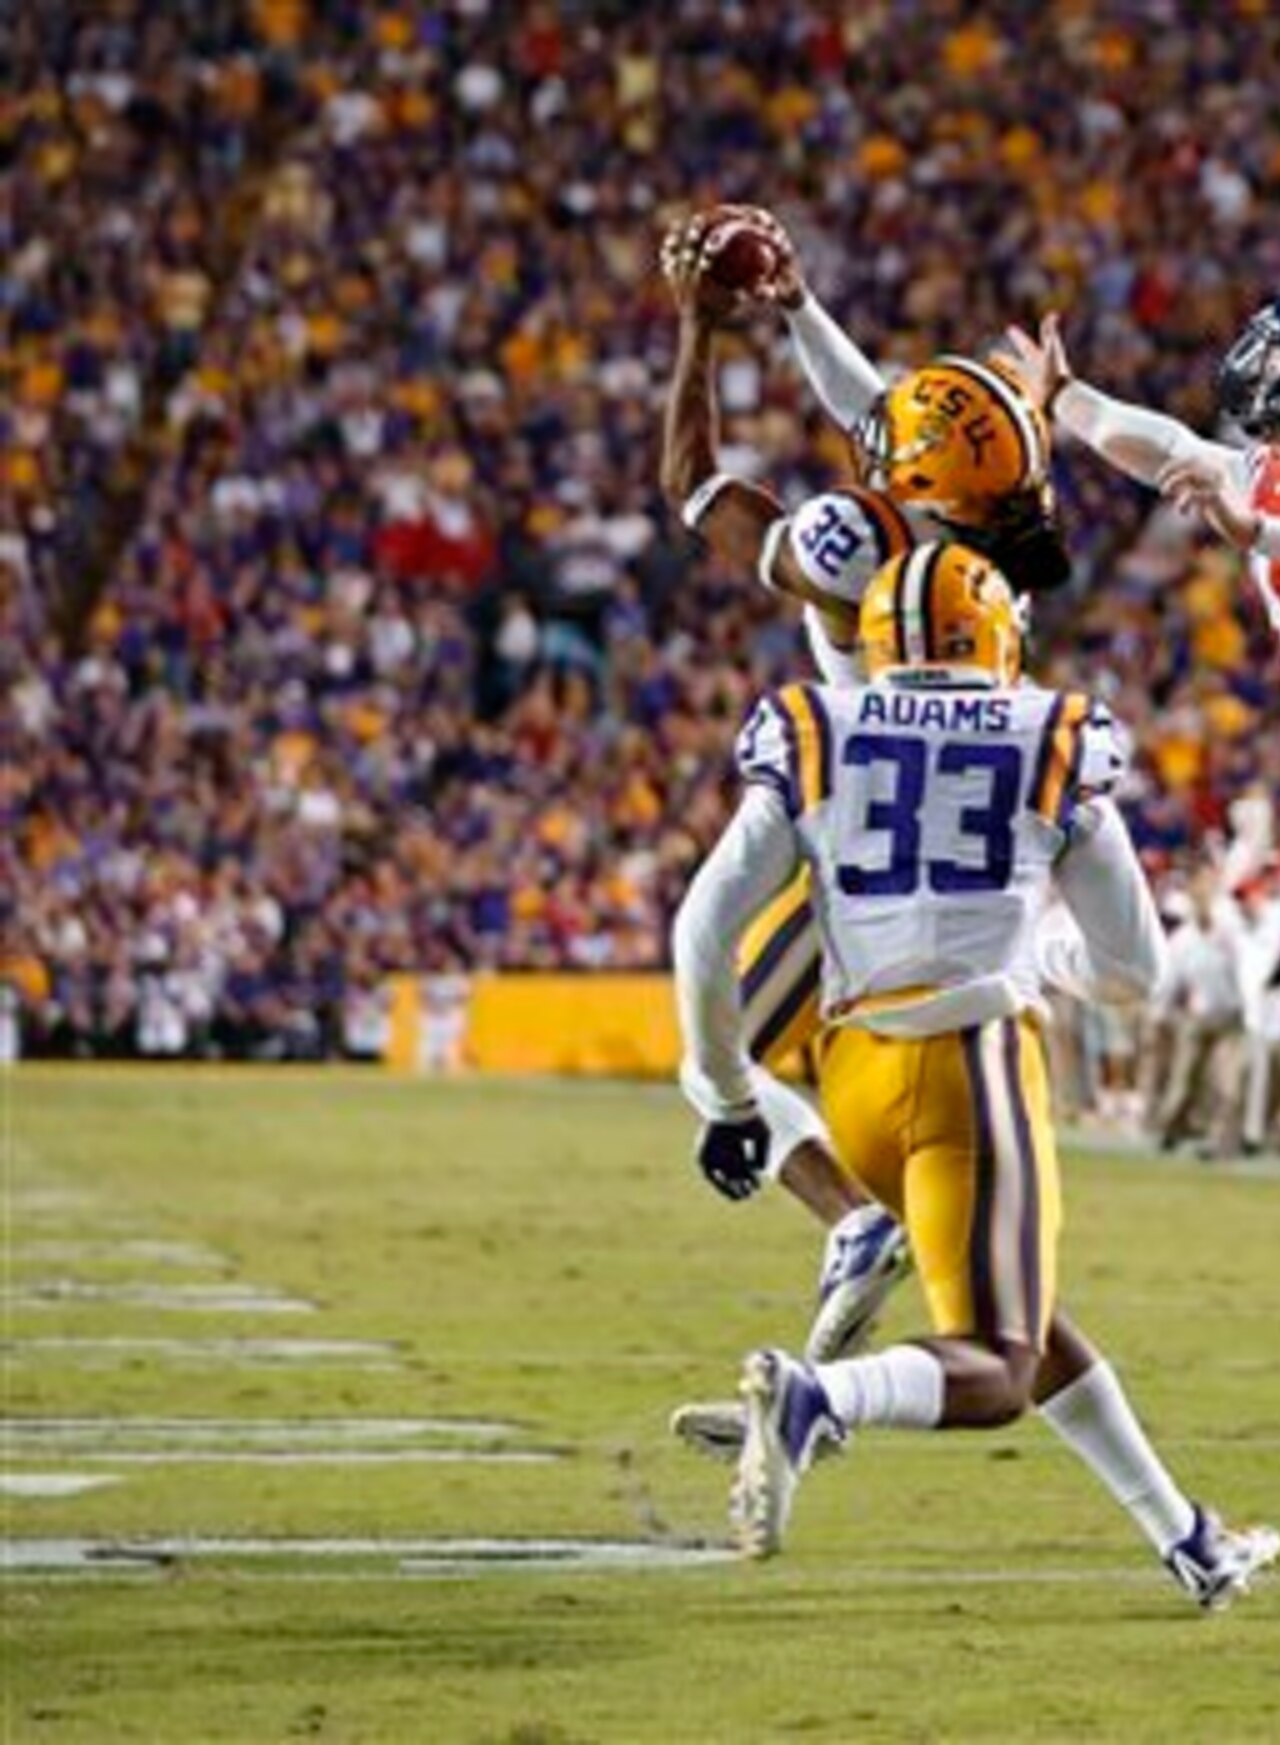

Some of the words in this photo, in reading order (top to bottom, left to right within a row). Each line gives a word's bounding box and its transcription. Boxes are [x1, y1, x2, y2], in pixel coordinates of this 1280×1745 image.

[800, 503, 863, 578] 32
[858, 693, 1012, 732] ADAMS
[836, 734, 1023, 896] 33
